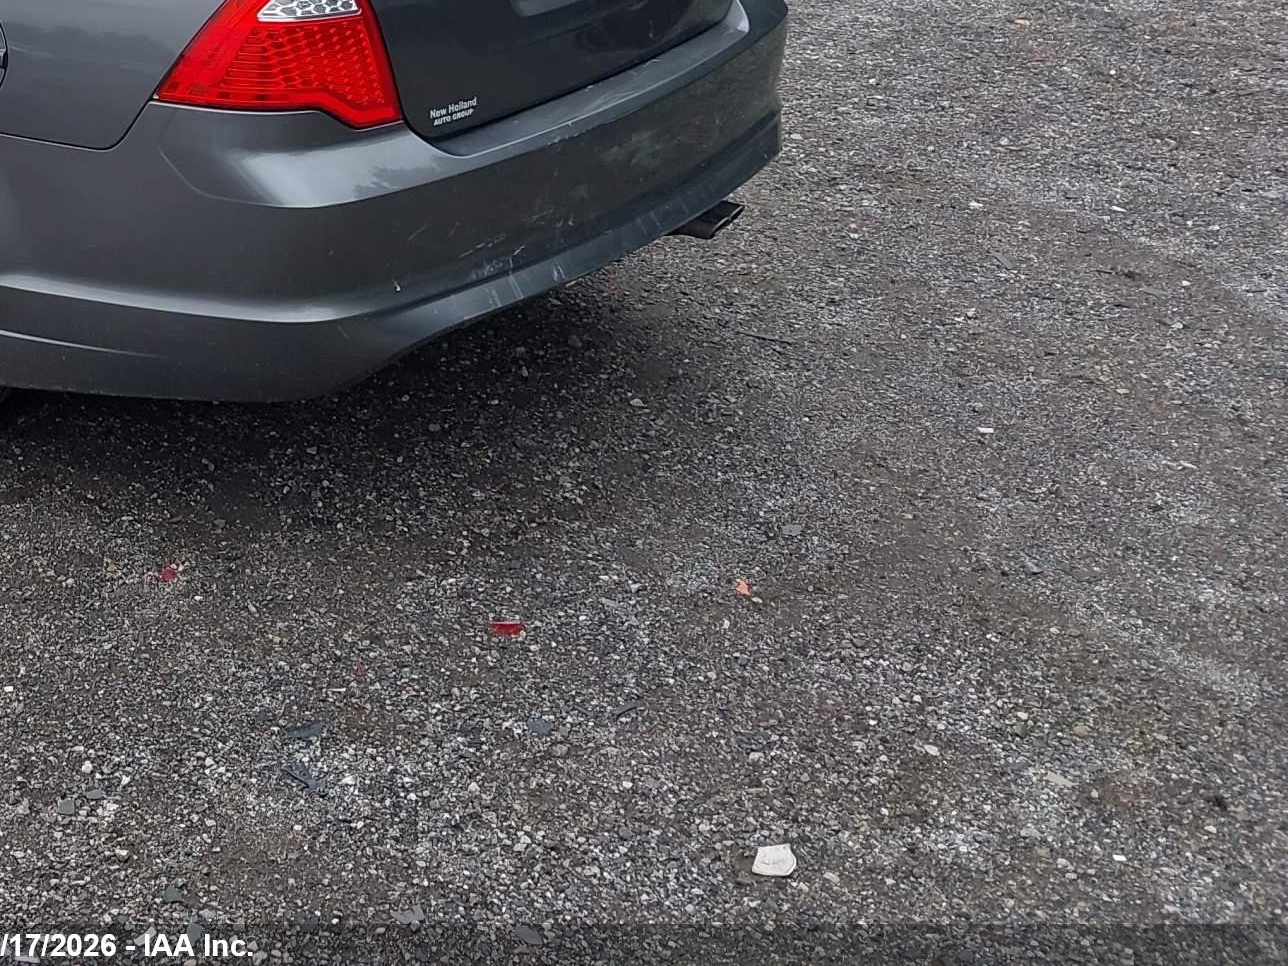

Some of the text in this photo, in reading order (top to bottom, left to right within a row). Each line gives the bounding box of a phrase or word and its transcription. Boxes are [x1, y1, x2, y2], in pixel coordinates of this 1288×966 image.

[430, 96, 477, 119] New Holland
[433, 108, 474, 126] AUTO GROUP
